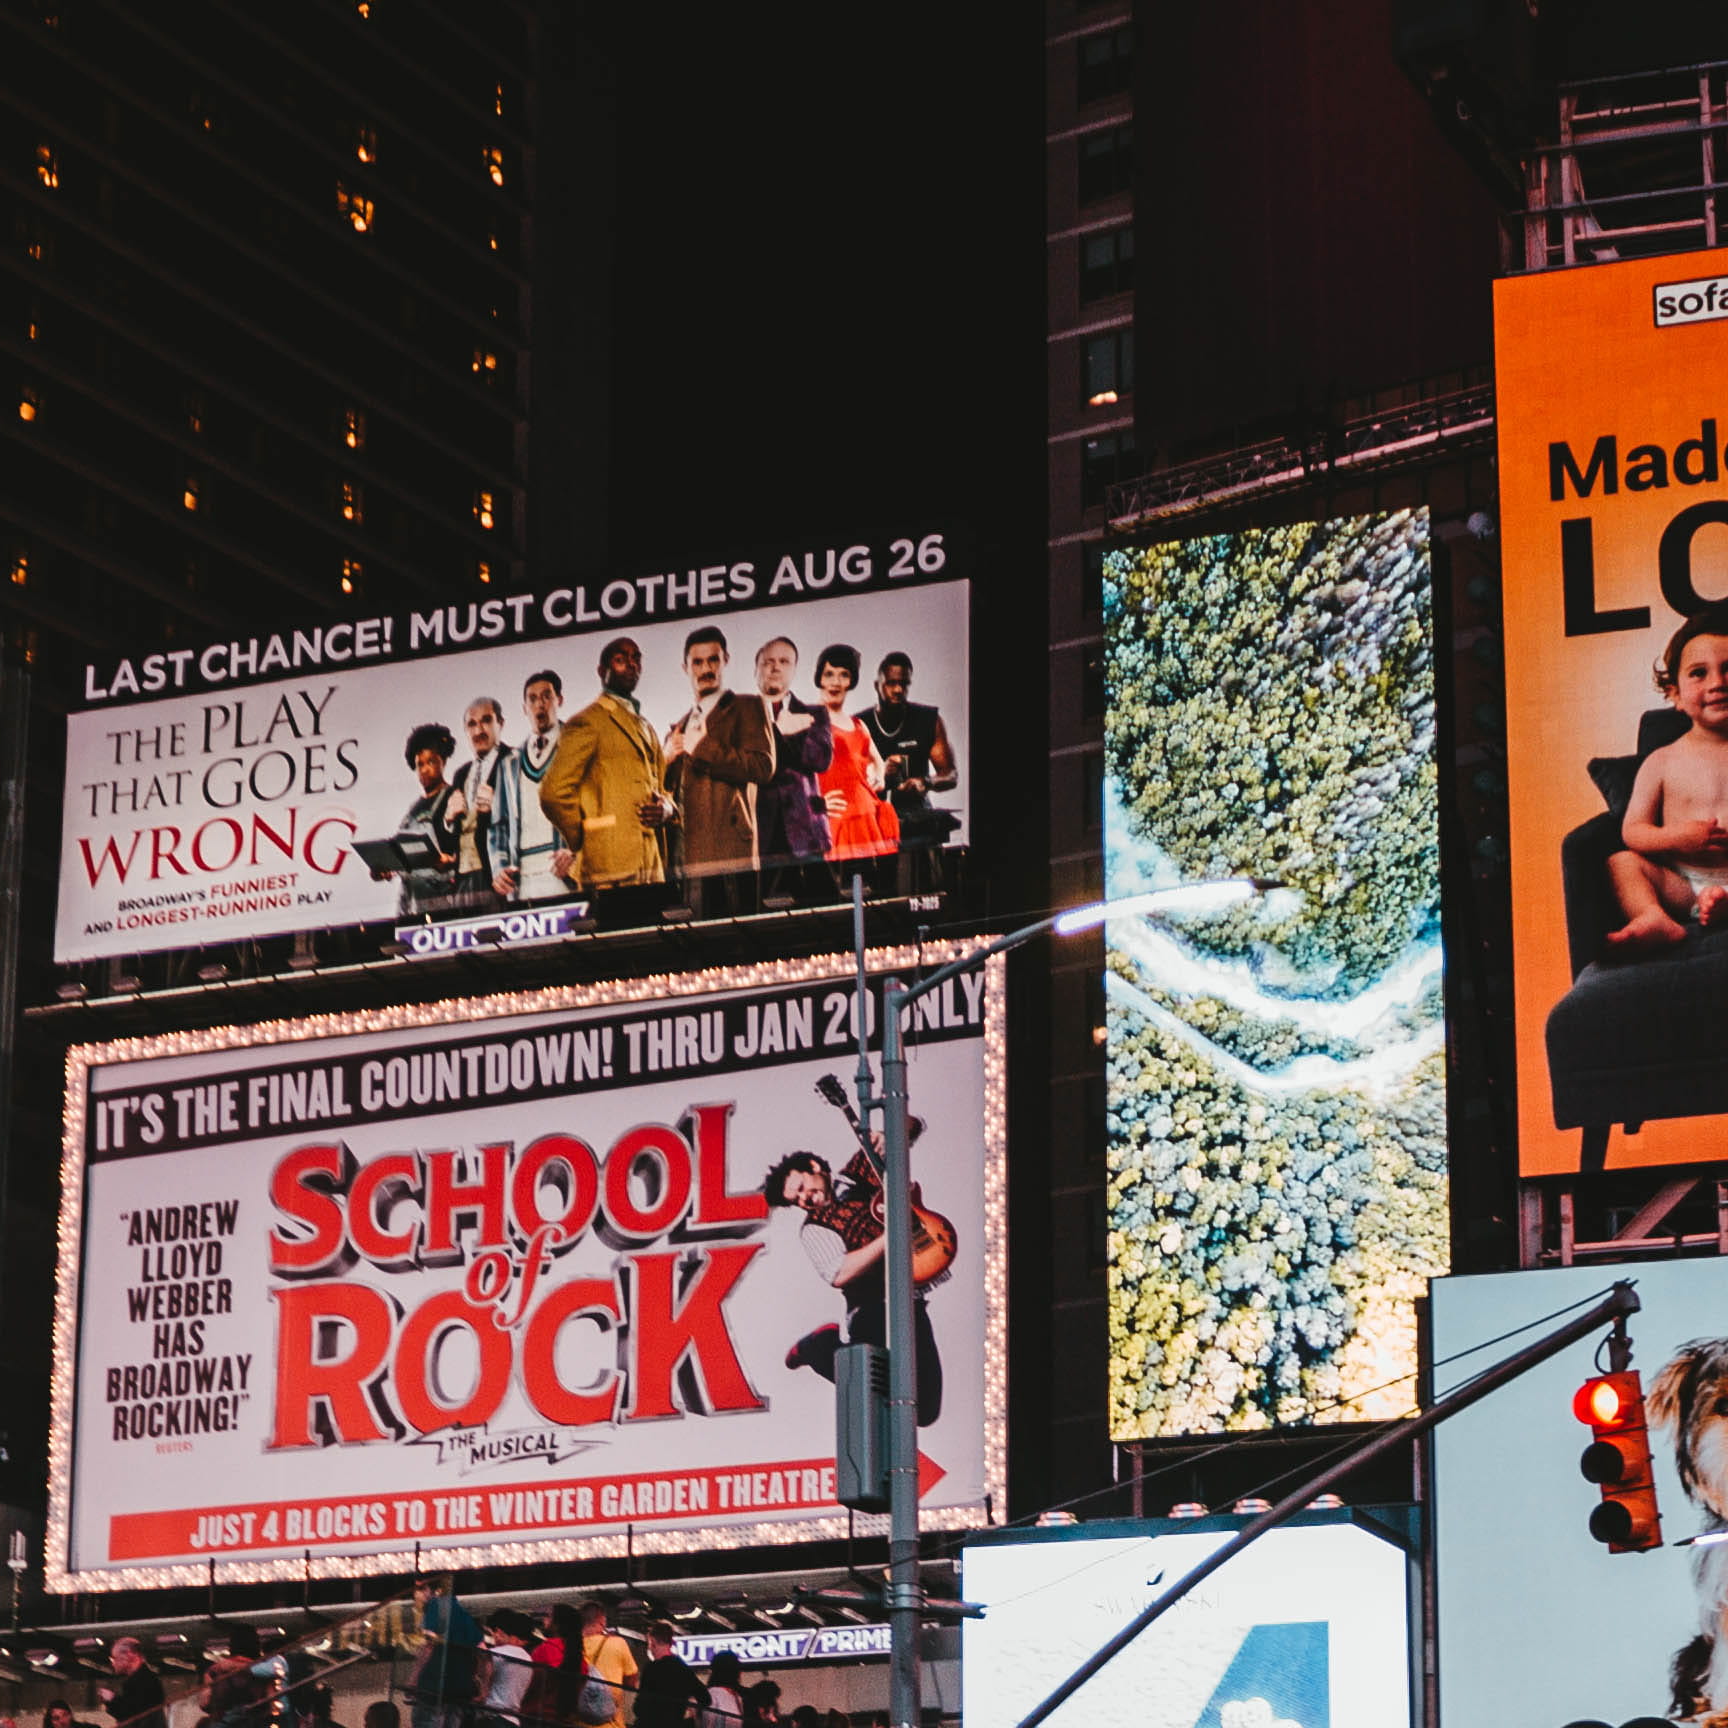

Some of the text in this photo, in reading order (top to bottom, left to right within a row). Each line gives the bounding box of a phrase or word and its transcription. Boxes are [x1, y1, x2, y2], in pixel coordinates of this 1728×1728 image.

[85, 533, 947, 700] LAST CHANCE! MUST CLOTHES AUG 26
[106, 685, 339, 766] THE PLAY
[82, 738, 360, 818] THAT GOES
[76, 807, 358, 890] WRONG
[210, 872, 299, 900] FUNNIEST
[83, 890, 334, 936] AND LONGEST-RUNNING PLAY
[412, 910, 566, 954] OUTONT
[96, 1093, 164, 1151] IT'S
[173, 1081, 240, 1138] THE
[248, 1066, 352, 1127] FINAL
[360, 1027, 614, 1112] COUNTDOWN!
[623, 1009, 725, 1075] THRU
[734, 996, 814, 1059] JAN
[823, 987, 876, 1047] 20
[268, 1099, 772, 1278] SCHOOL
[142, 1240, 223, 1283] LLOYD
[462, 1222, 567, 1330] of
[127, 1277, 232, 1323] WEBBER
[153, 1319, 206, 1360] HAS
[262, 1243, 770, 1455] ROCK
[106, 1353, 253, 1404] BROADWAY
[448, 1431, 477, 1452] THE
[471, 1431, 560, 1464] MUSICAL
[190, 1466, 836, 1549] JUST 4 BLOCKS TO THE WINTER GARDEN THEATRE
[671, 1632, 809, 1664] UTFRONT
